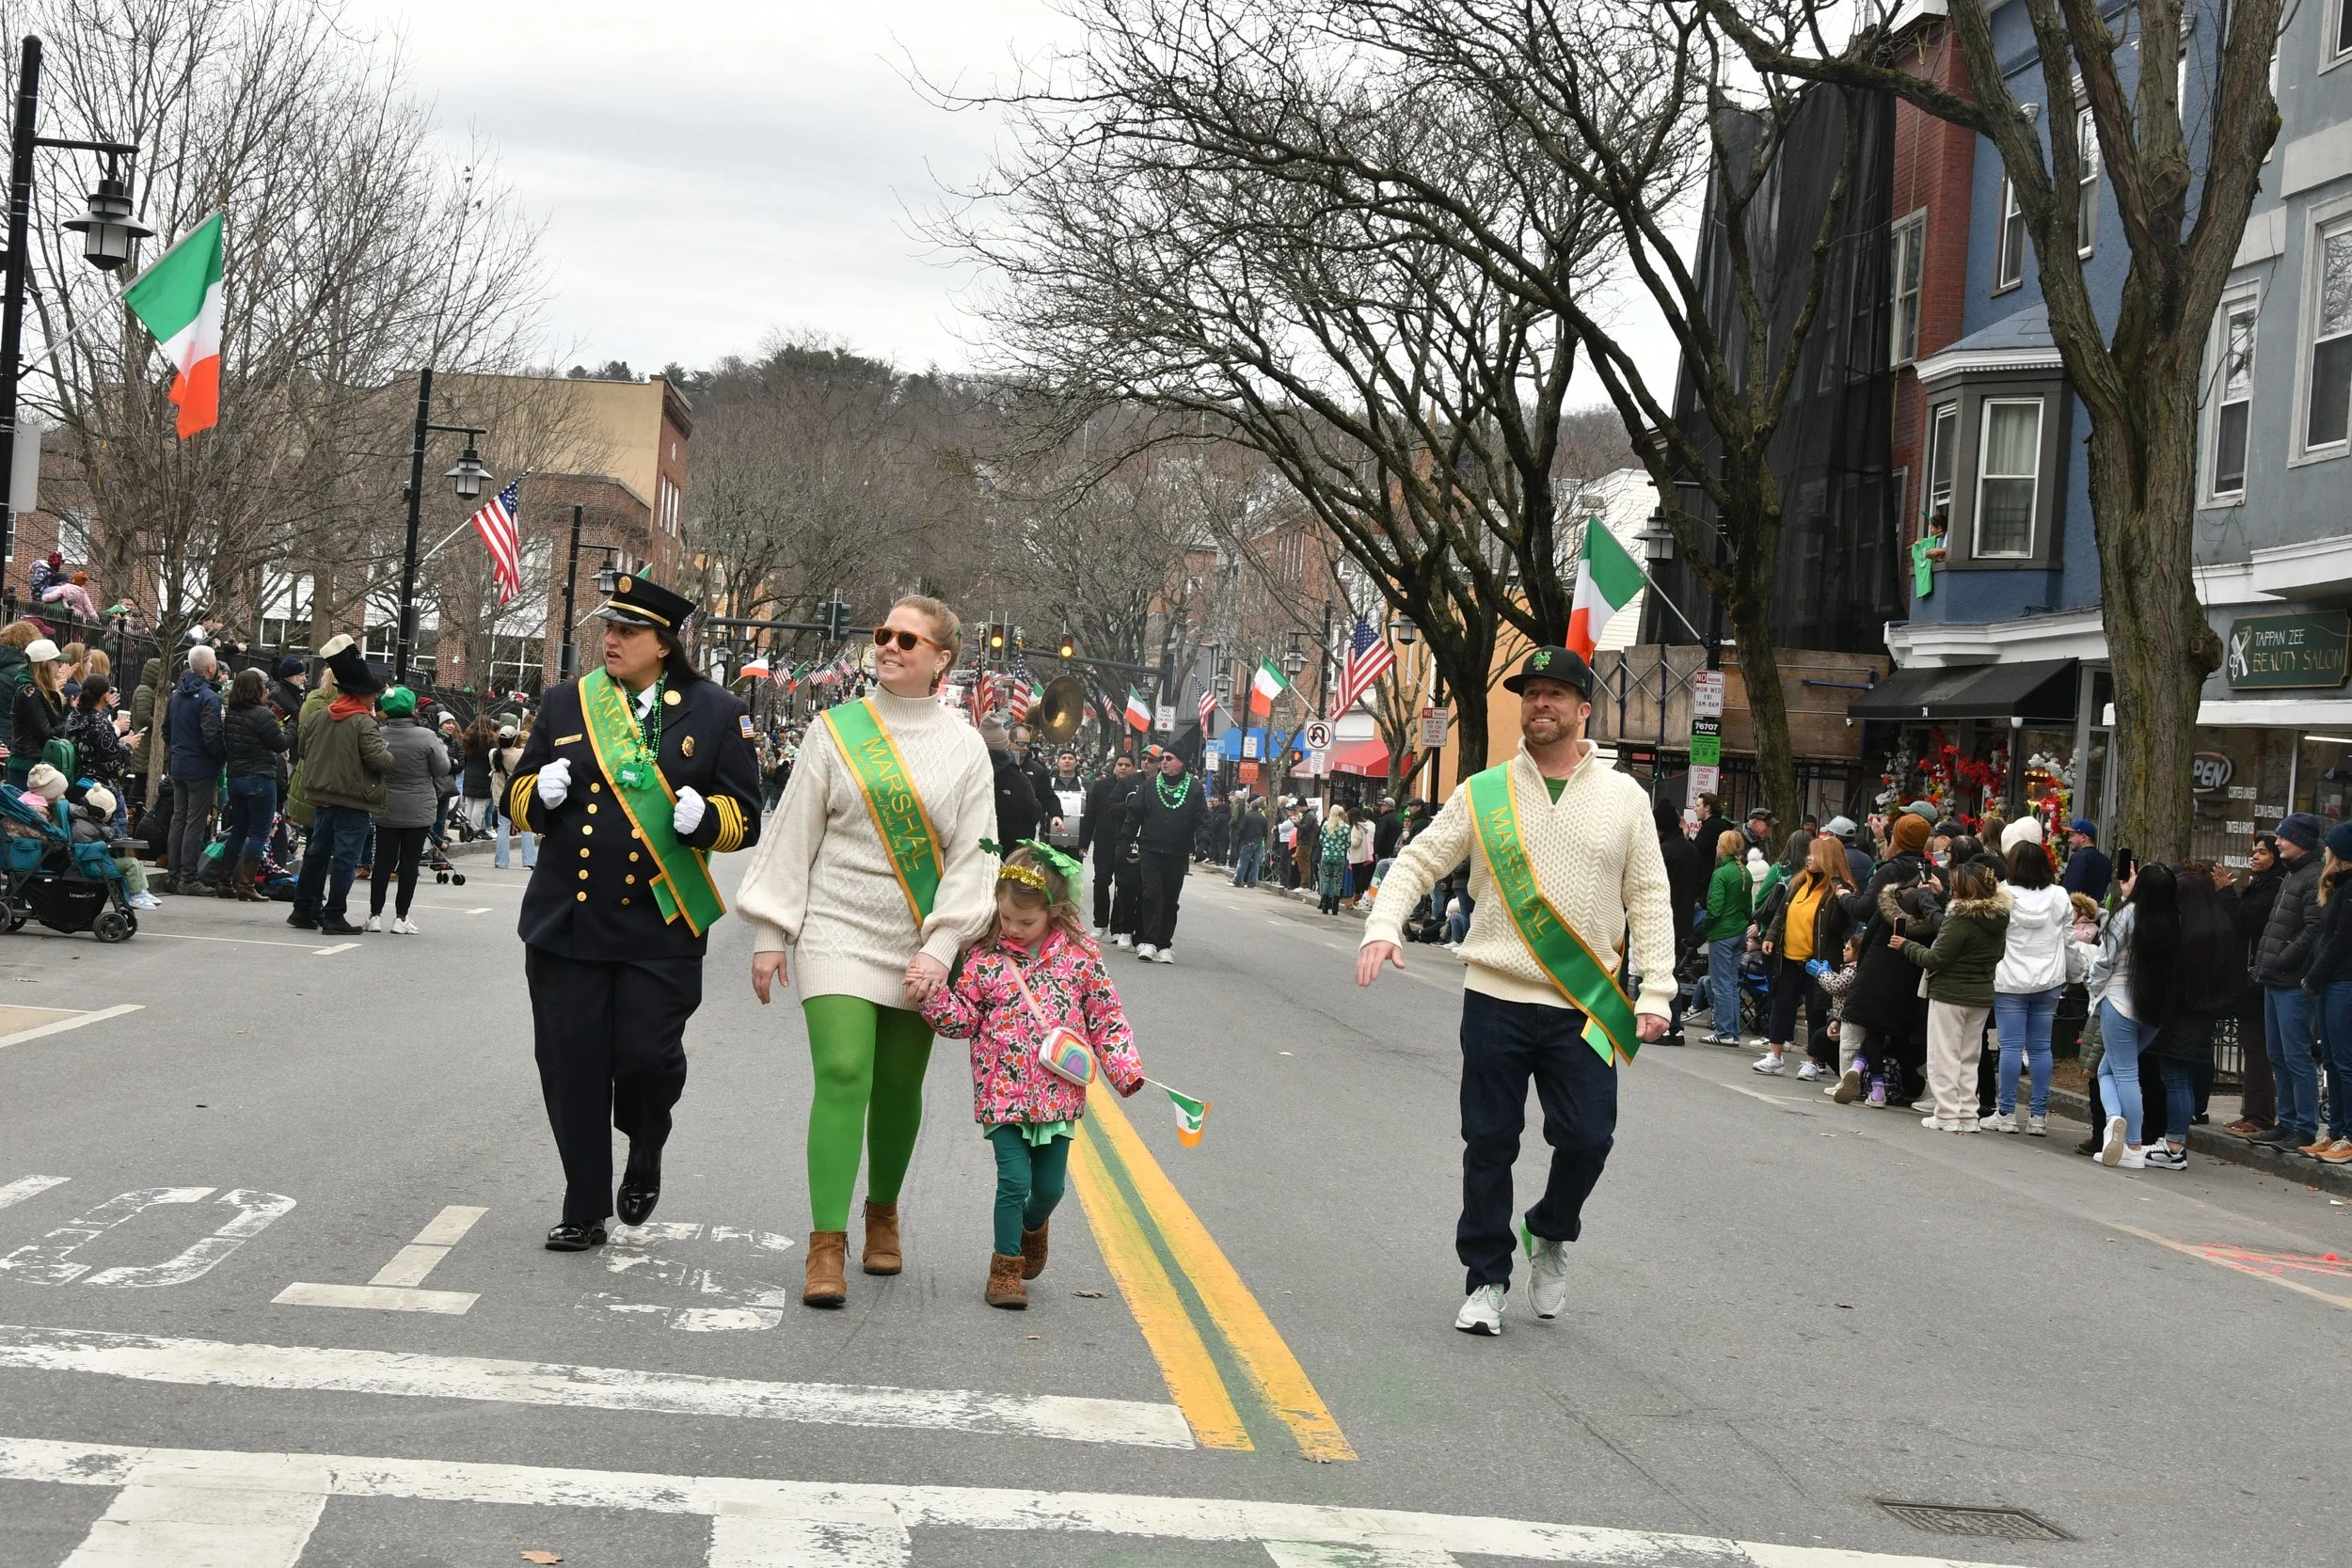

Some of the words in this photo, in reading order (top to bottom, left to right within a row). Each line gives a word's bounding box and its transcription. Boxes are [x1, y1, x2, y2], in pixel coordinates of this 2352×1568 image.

[2255, 630, 2285, 647] TAPPAN
[2288, 628, 2306, 645] ZEE
[2252, 650, 2296, 673] BEAUTY
[2302, 647, 2344, 671] SALON
[1696, 673, 1707, 683] NO
[596, 676, 637, 765] MARSH
[1922, 706, 1929, 718] 74
[1694, 722, 1719, 731] 76707
[2193, 759, 2227, 788] PEN
[863, 737, 929, 870] MARSHAL
[1489, 807, 1550, 936] MARSHAL
